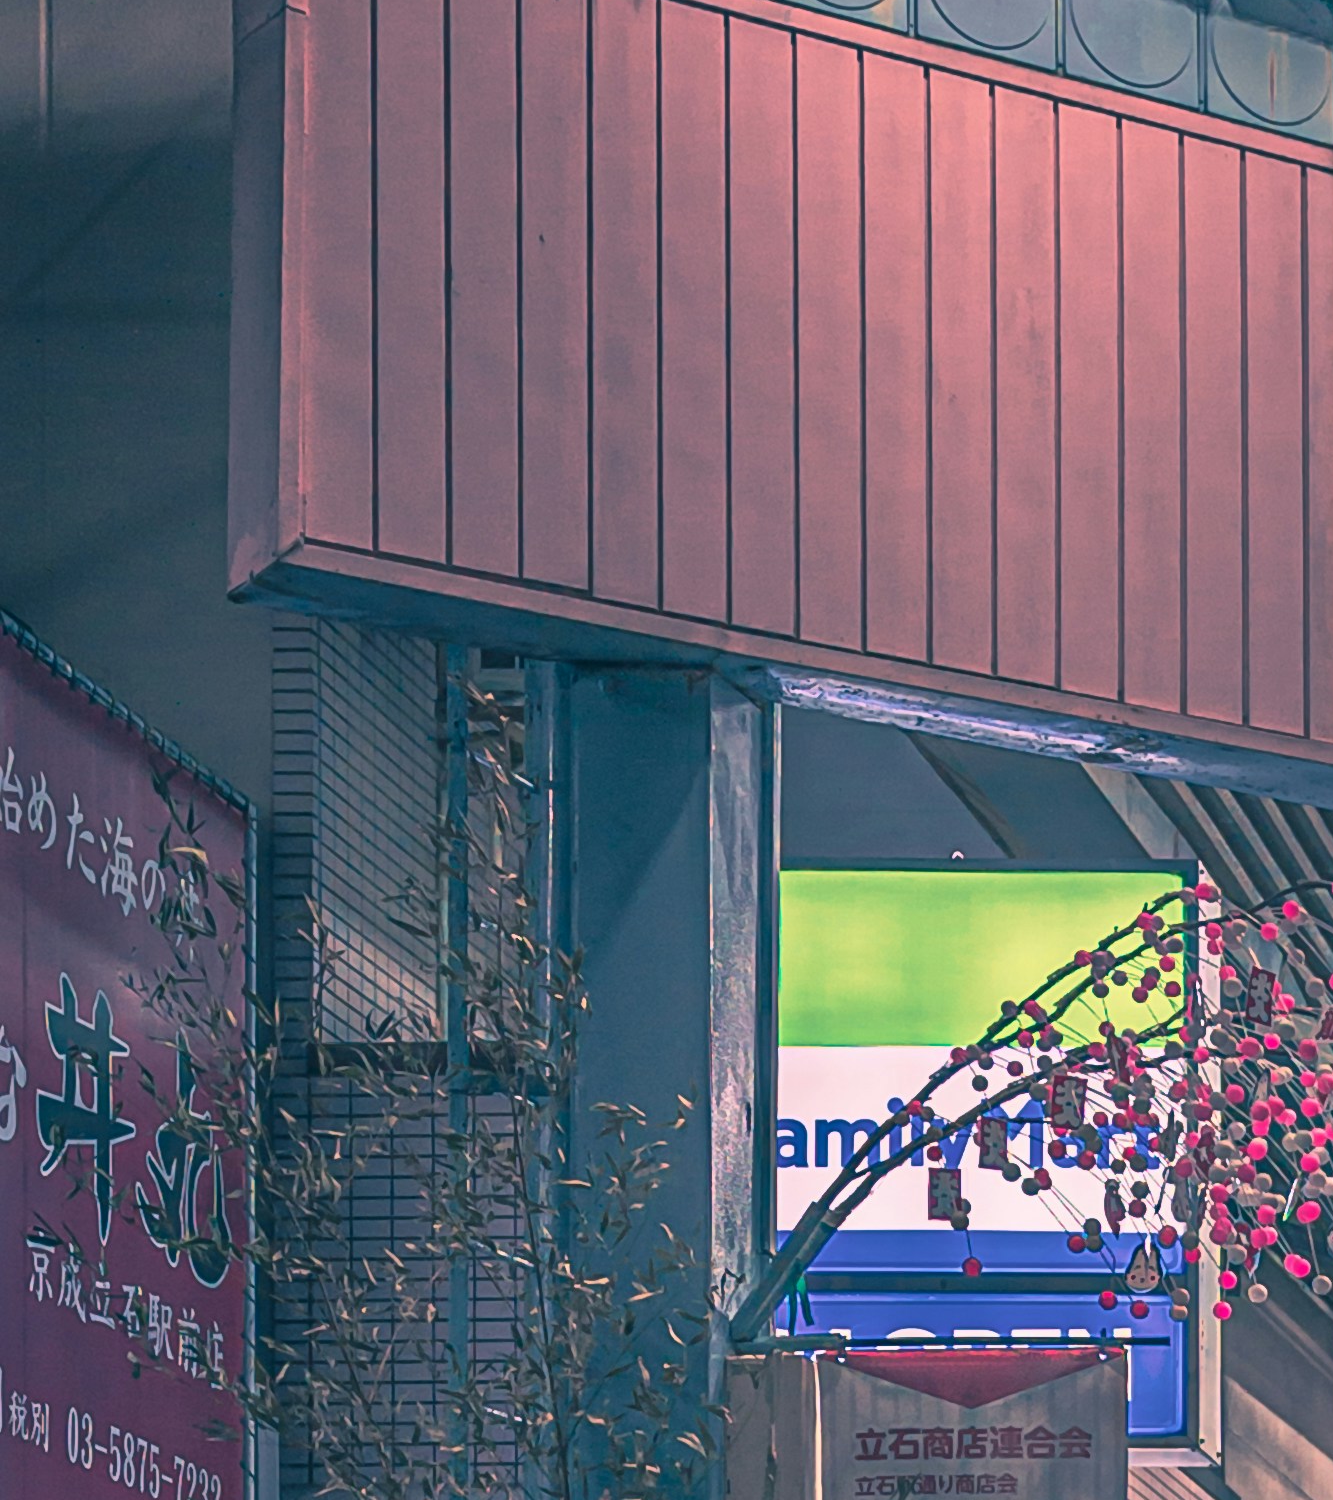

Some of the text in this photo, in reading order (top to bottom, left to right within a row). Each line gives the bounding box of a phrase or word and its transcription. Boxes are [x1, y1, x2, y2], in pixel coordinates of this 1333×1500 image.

[854, 1426, 1093, 1461] 立石商店連合会
